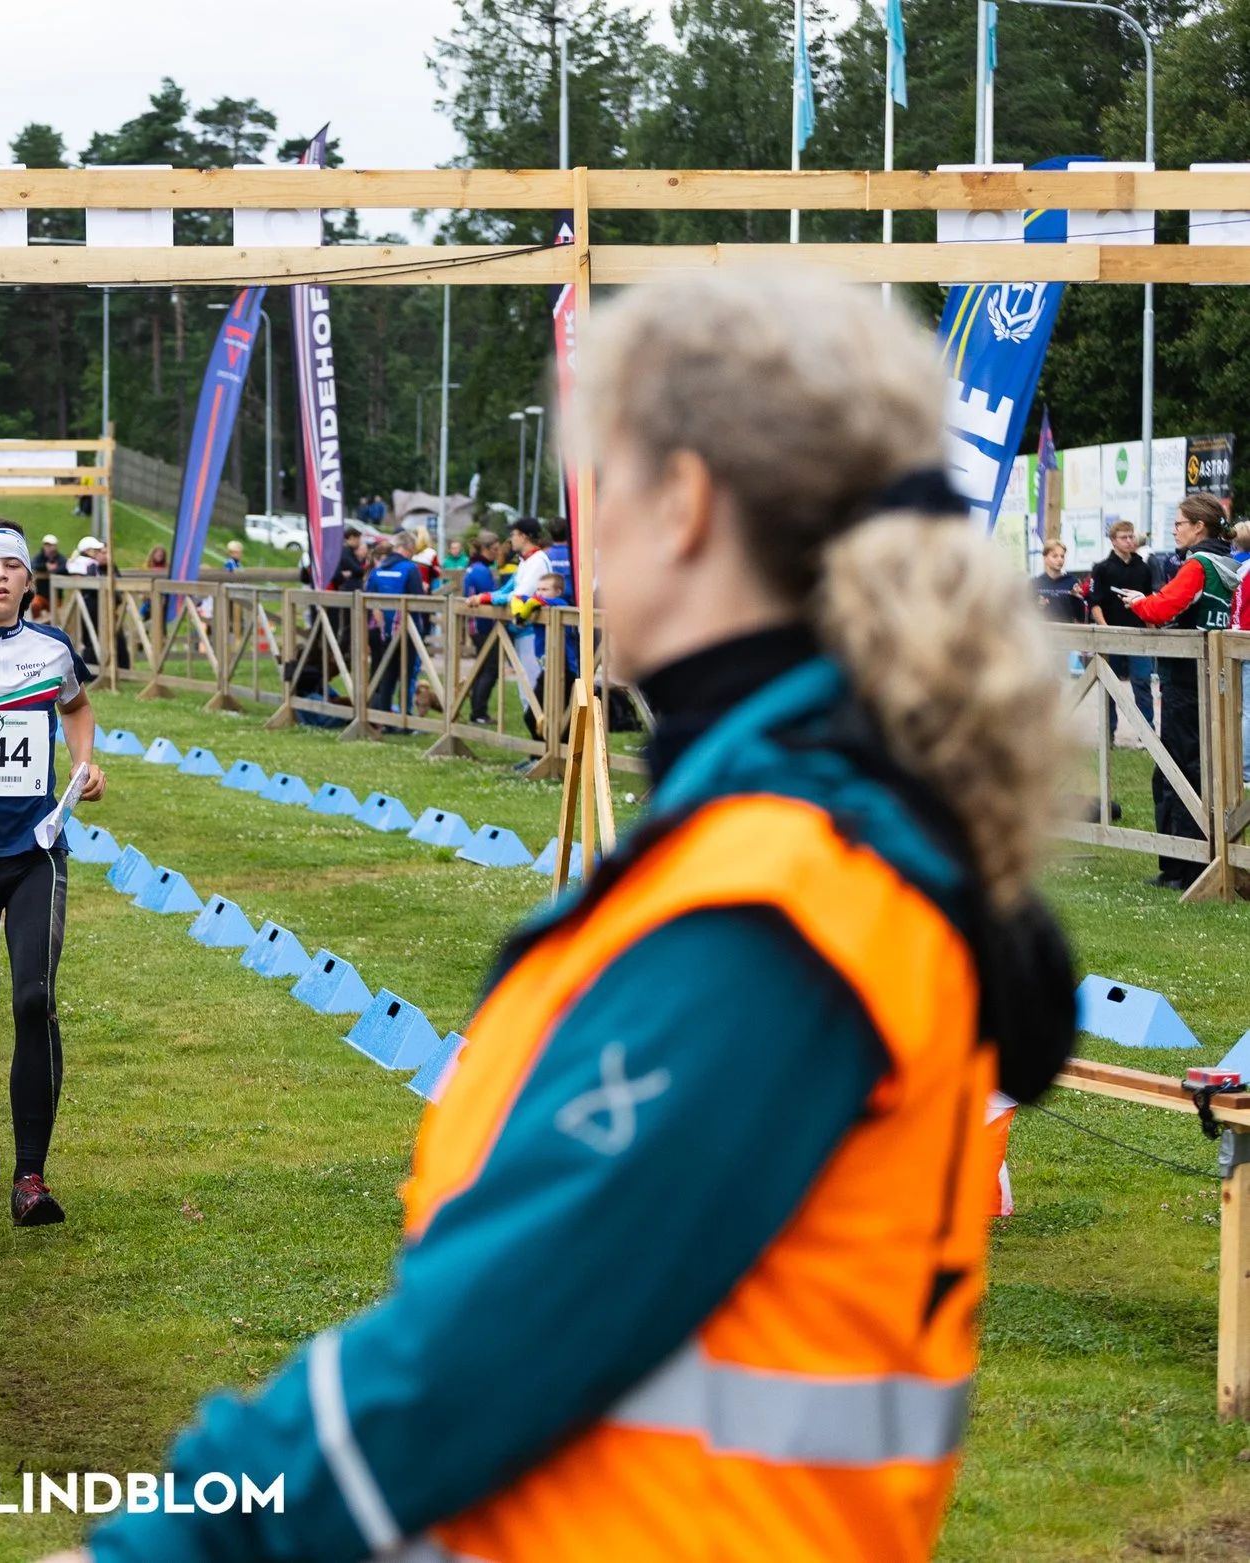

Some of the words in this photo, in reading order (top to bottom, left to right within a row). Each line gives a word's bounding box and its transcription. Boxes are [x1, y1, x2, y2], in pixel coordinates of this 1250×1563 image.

[309, 287, 343, 527] LANDEHOF
[1206, 611, 1230, 628] LED
[35, 779, 41, 790] 8
